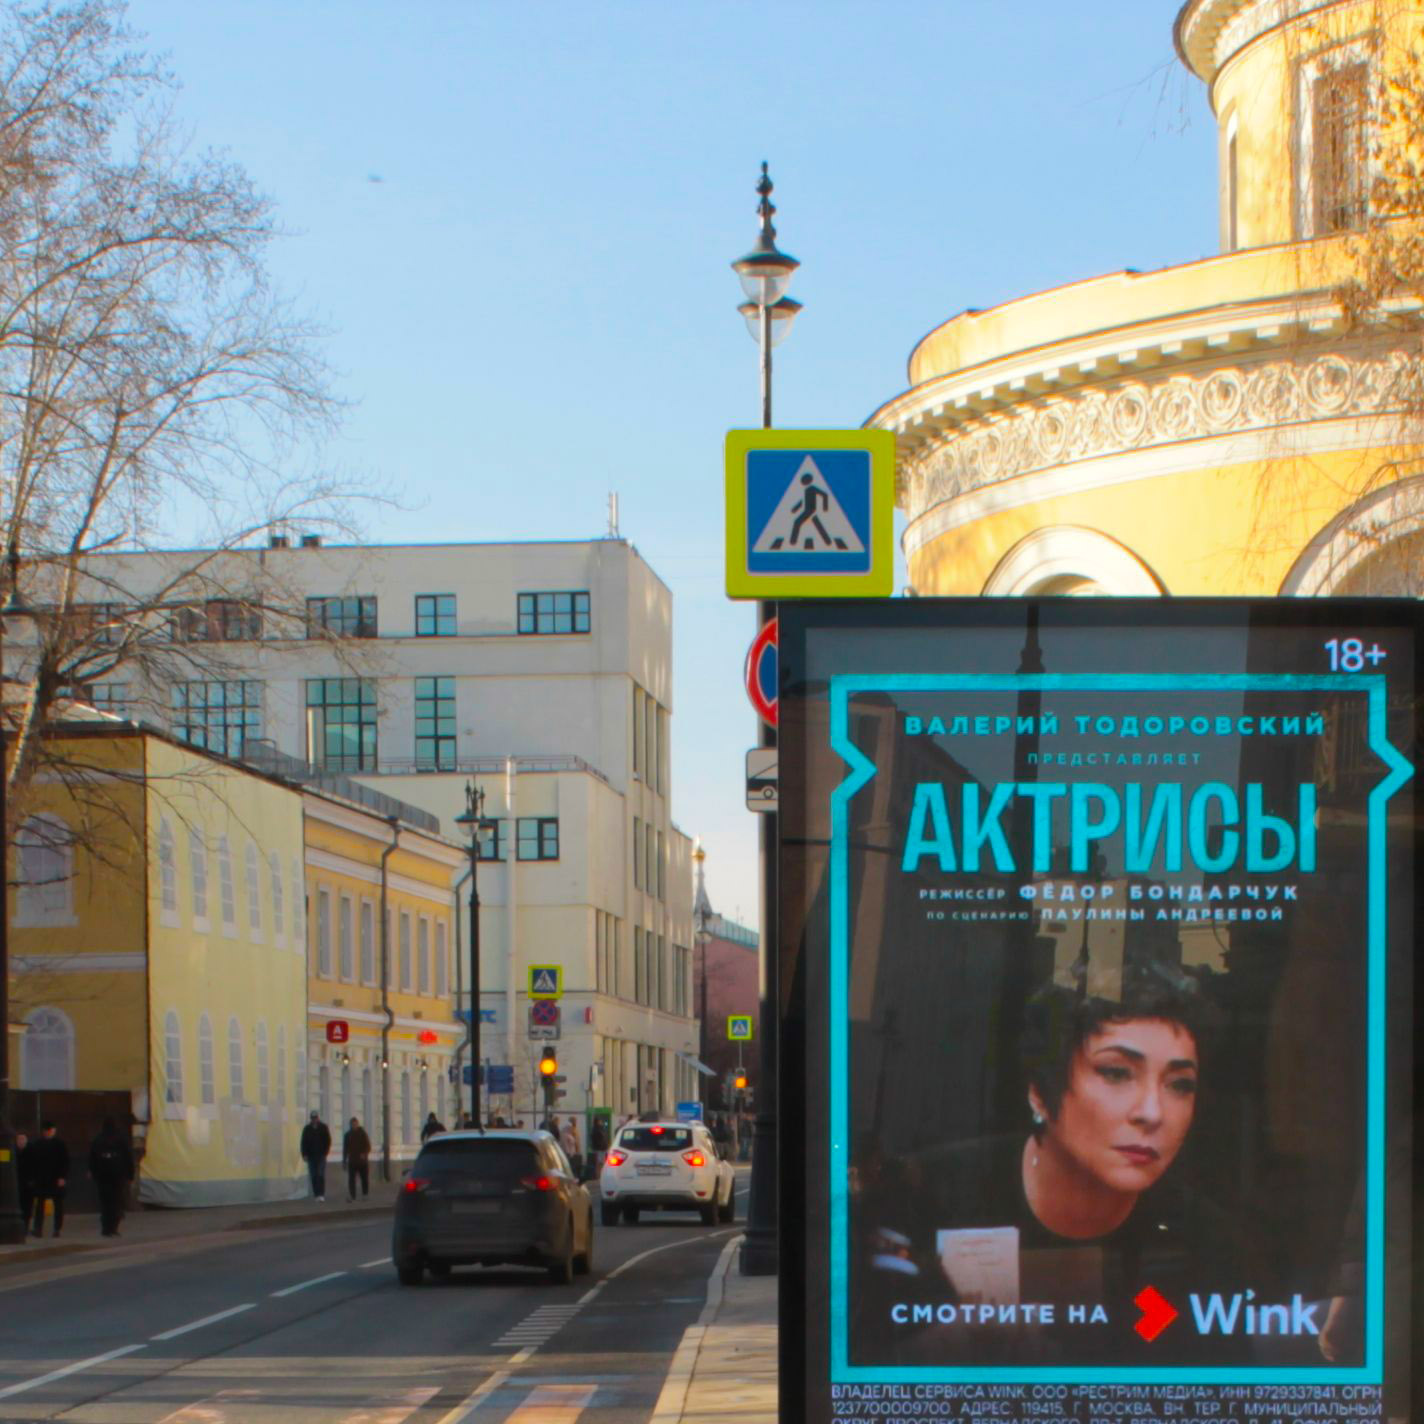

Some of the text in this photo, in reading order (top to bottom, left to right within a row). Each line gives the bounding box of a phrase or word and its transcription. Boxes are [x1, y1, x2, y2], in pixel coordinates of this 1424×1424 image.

[1324, 638, 1387, 672] 18+
[904, 711, 1324, 738] ВАЛЕРИЙ ТОДОРОВСКИЙ
[1027, 752, 1201, 767] ПРЕДСТАВЛЯЕТ
[901, 781, 1318, 874] АКТРИСЫ
[919, 883, 1299, 902] РЕЖИССЁР ФЁДОР БОНДАРЧУК
[926, 906, 1283, 923] ПО СЦЕНАРИЮ ПАУЛИНЫ АНДРЕЕВОЙ
[891, 1303, 1109, 1325] СМОТРИТЕ НА
[1189, 1289, 1320, 1336] Wink
[832, 1385, 912, 1400] ВЛАДЕЛЕЦ
[914, 1385, 984, 1399] СЕРВИСА
[1032, 1385, 1068, 1399] ООО
[1072, 1385, 1150, 1399] «РЕСТРИМ
[1219, 1386, 1251, 1399] ИНН
[1342, 1386, 1383, 1400] ОГРН
[1244, 1400, 1383, 1417] МУНИЦИПАЛЬНЫЙ
